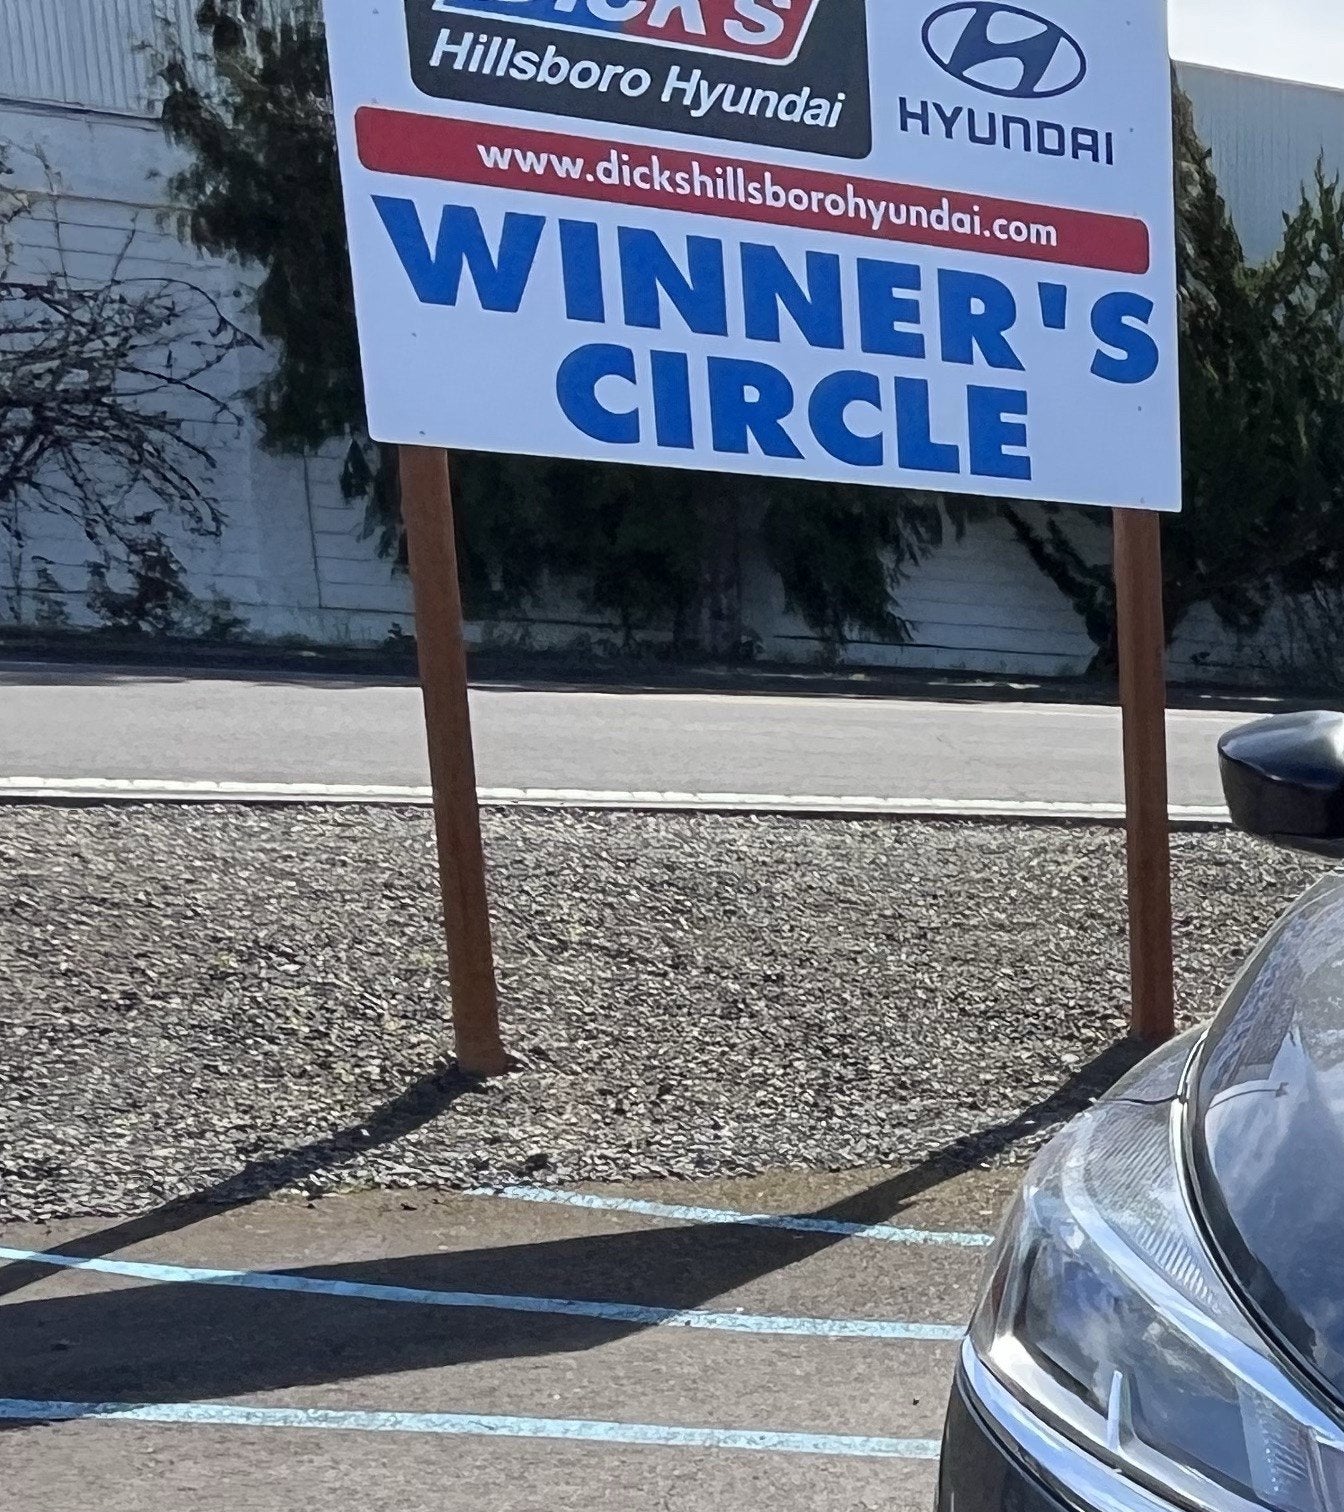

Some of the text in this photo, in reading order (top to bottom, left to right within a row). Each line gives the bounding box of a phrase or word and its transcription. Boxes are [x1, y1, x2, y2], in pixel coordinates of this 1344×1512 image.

[429, 28, 846, 128] Hillsboro Hyundai
[899, 96, 1114, 165] HYUNDAI
[477, 143, 1058, 248] www.dickshillsborohyundai.com
[371, 195, 1161, 386] WINNER'S
[555, 343, 1033, 482] CIRCLE
